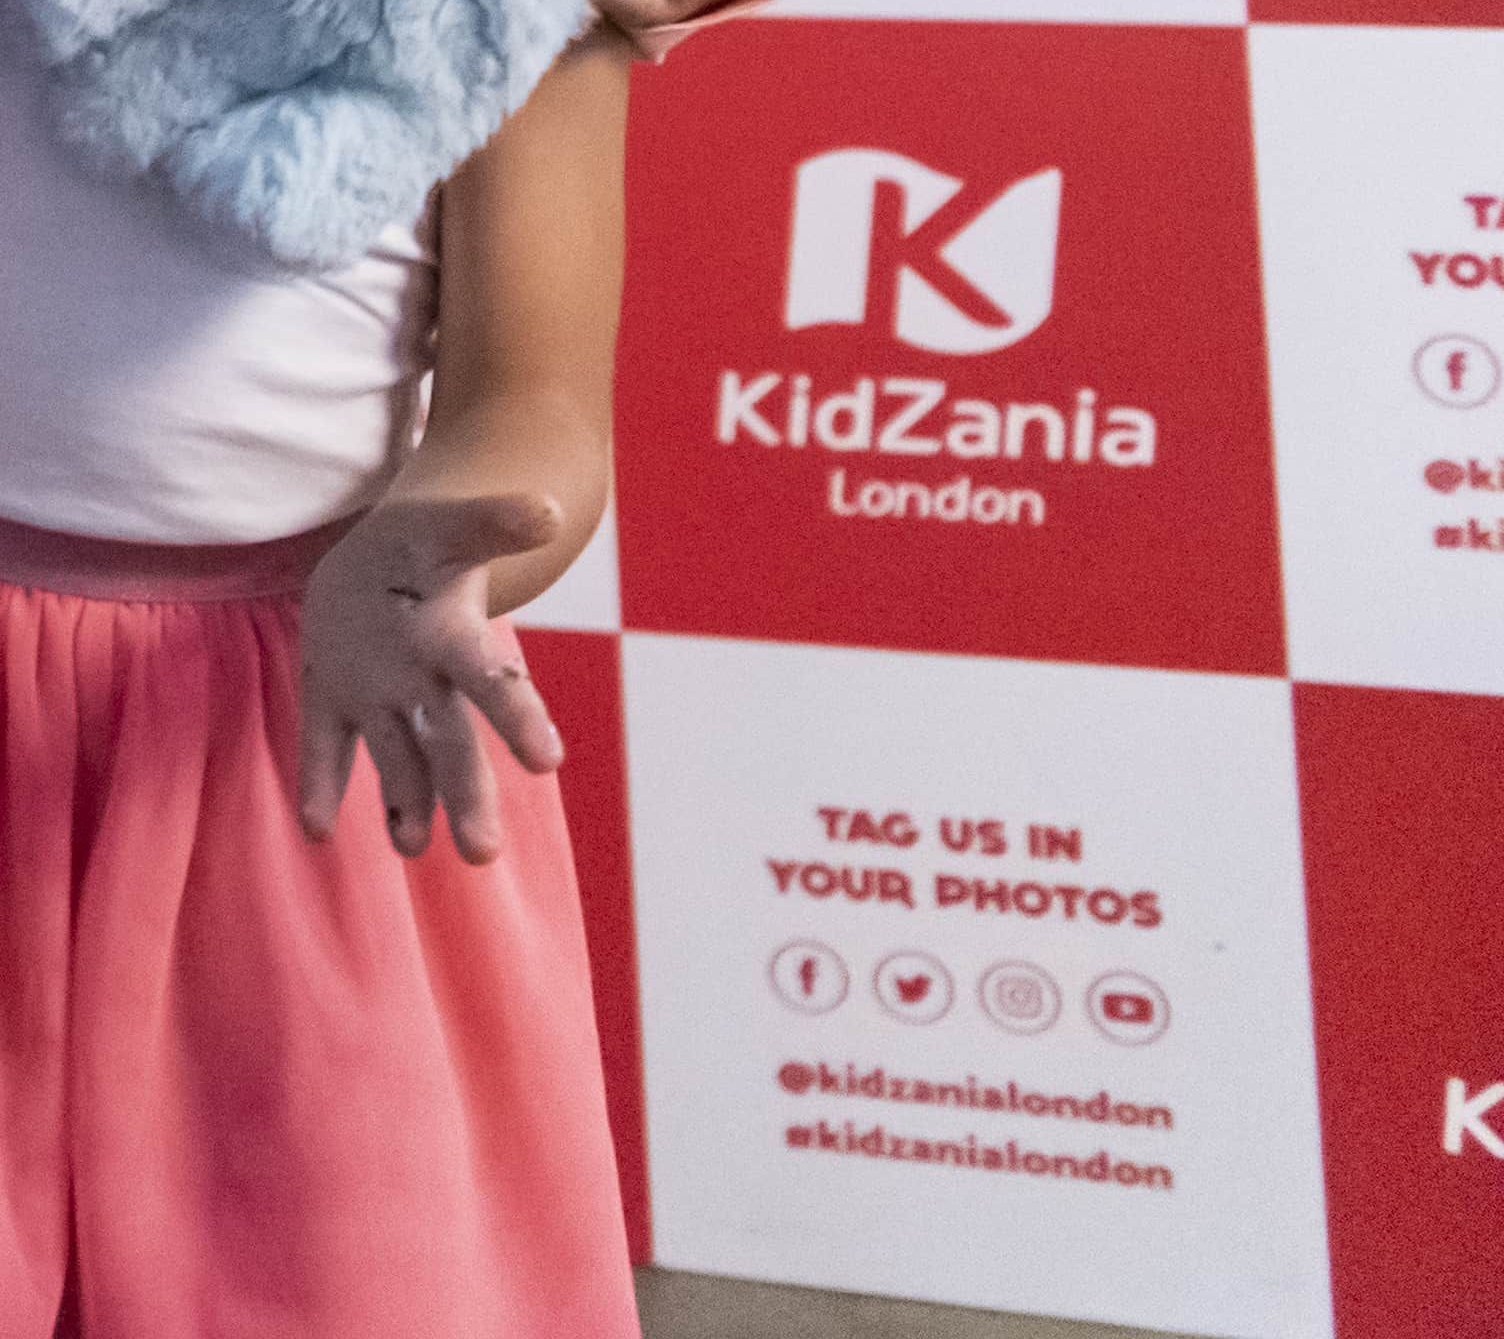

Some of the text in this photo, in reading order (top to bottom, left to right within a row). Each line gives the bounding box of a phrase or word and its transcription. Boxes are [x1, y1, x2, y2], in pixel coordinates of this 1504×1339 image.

[716, 370, 1157, 467] KidZania
[829, 471, 1045, 525] London
[818, 806, 1082, 861] TAG US IN
[767, 859, 1163, 928] YOUR PHOTOS
[776, 1061, 1174, 1128] @kidzanialondon
